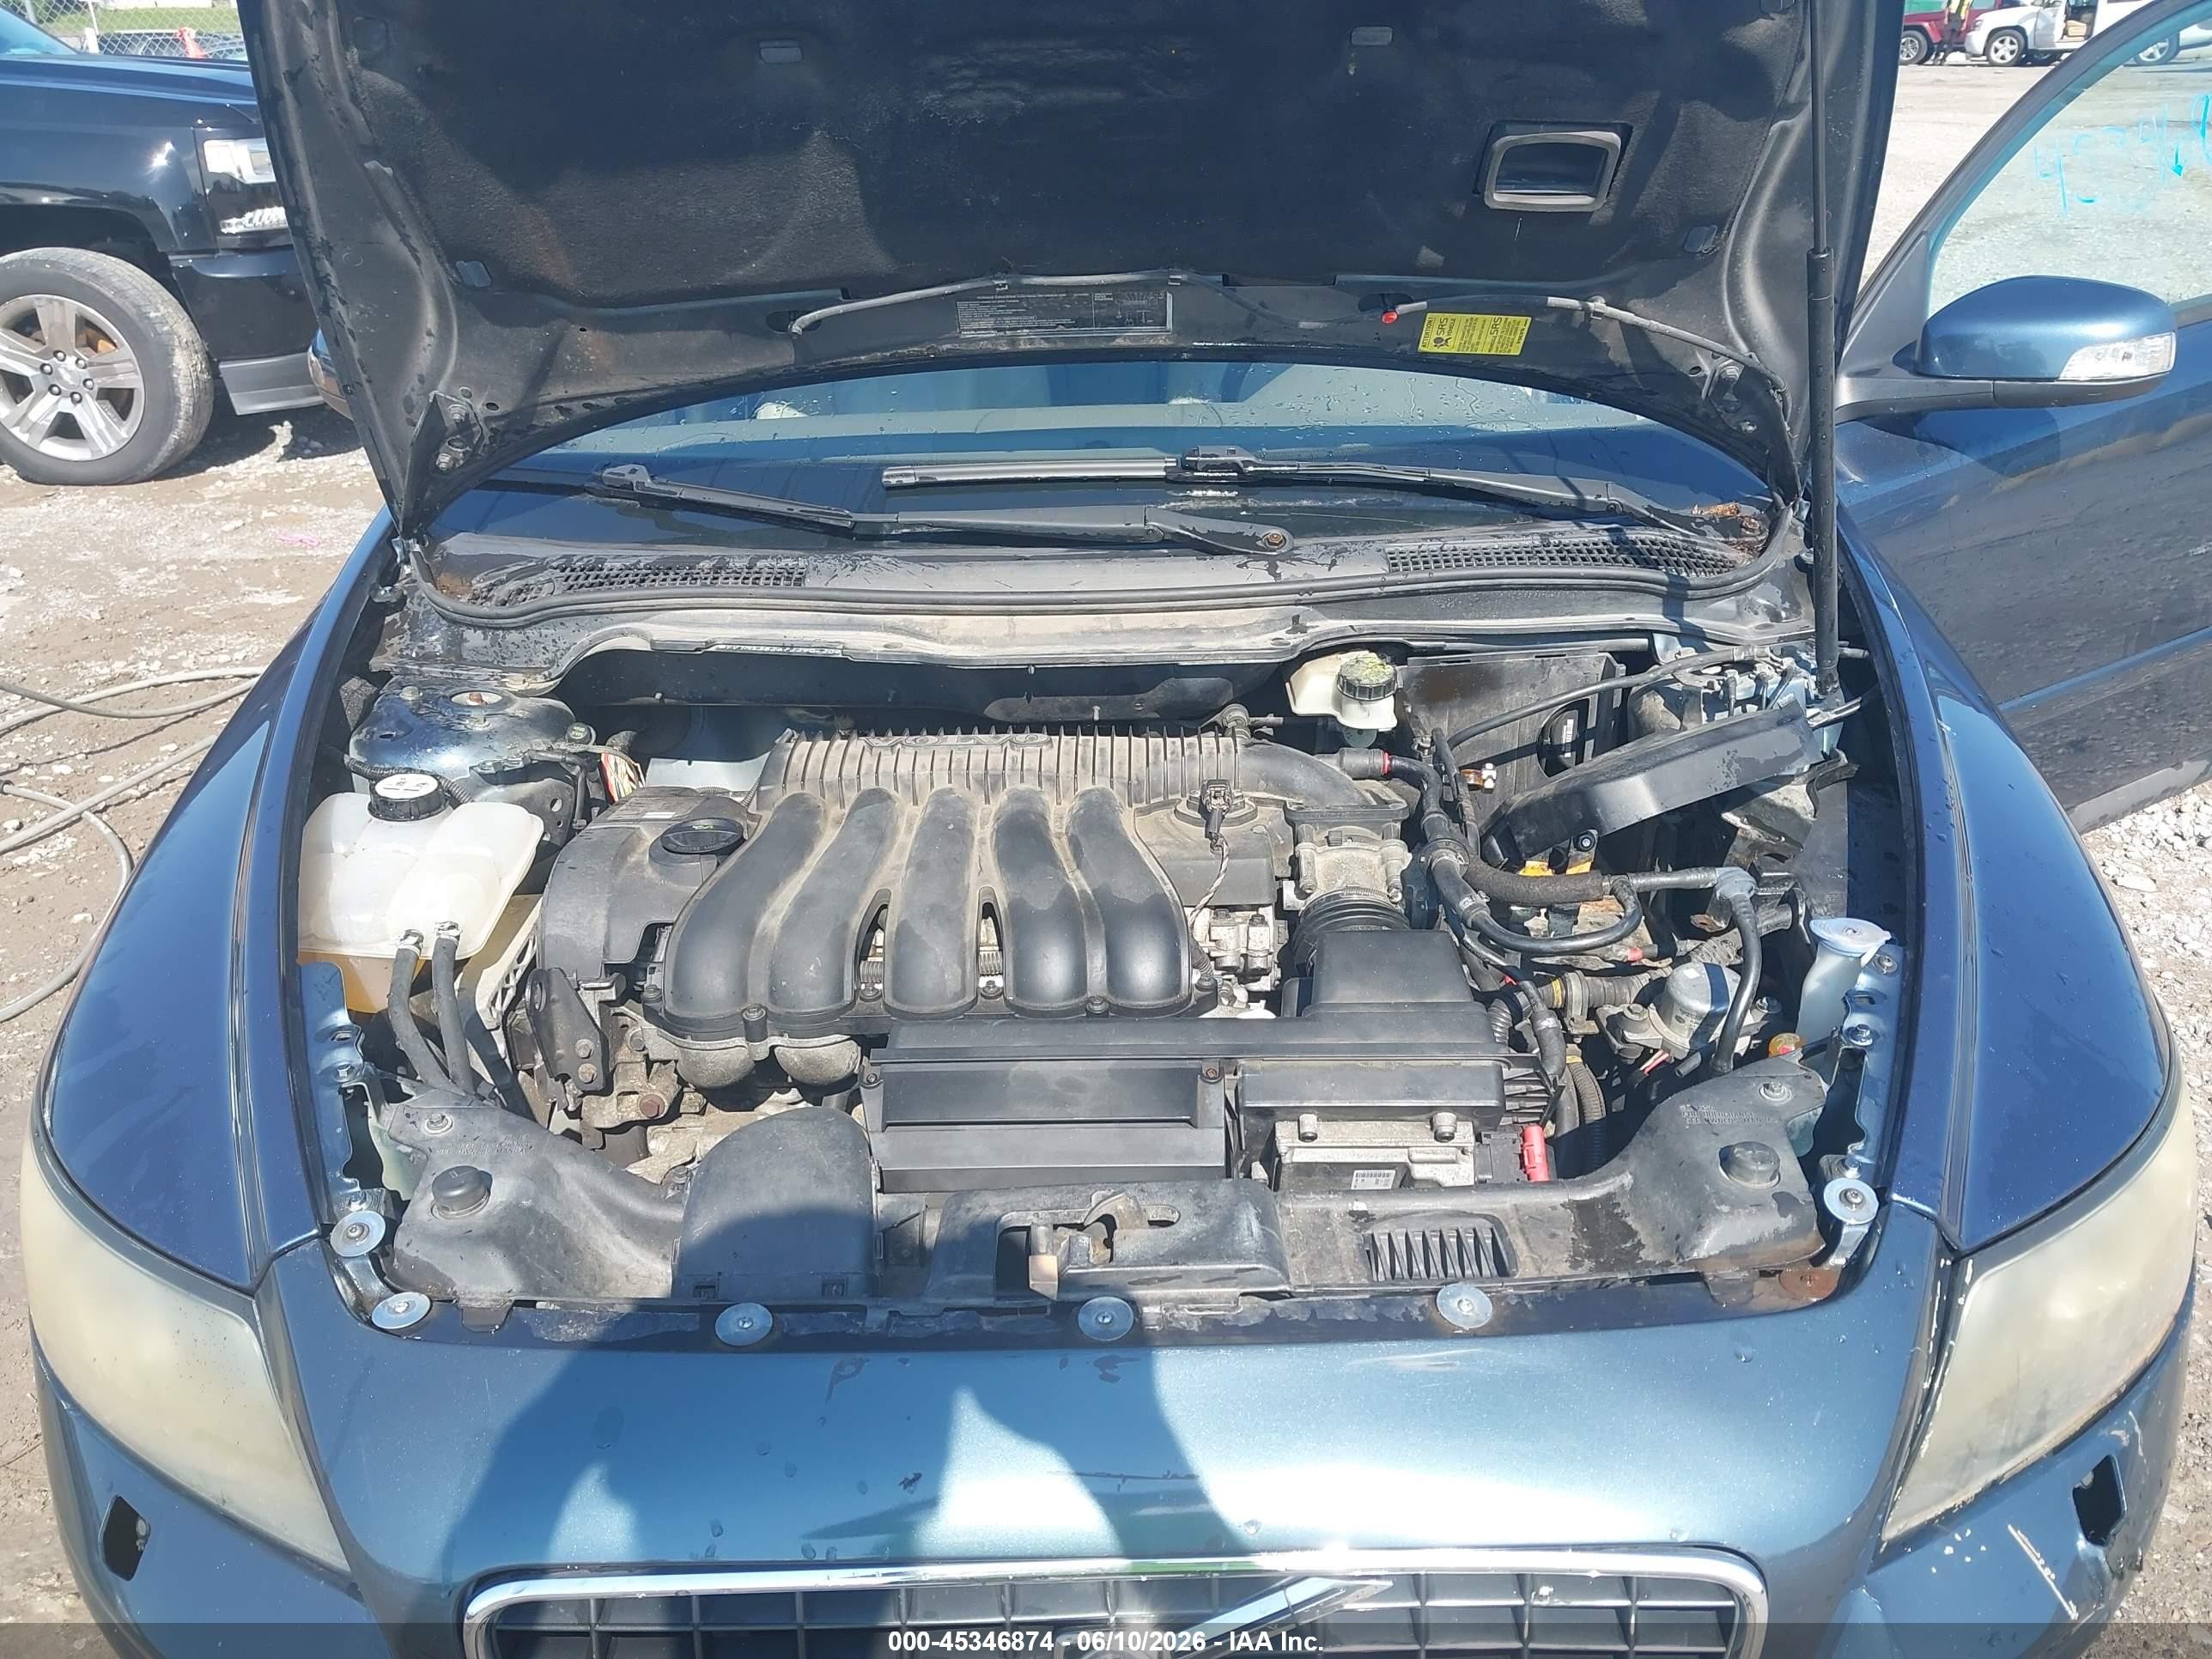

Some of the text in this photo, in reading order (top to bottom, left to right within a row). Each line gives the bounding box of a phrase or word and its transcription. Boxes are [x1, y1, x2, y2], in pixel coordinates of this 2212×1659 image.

[1436, 317, 1449, 336] SRS
[1490, 316, 1503, 336] SRS
[864, 732, 1053, 750] VOLVO
